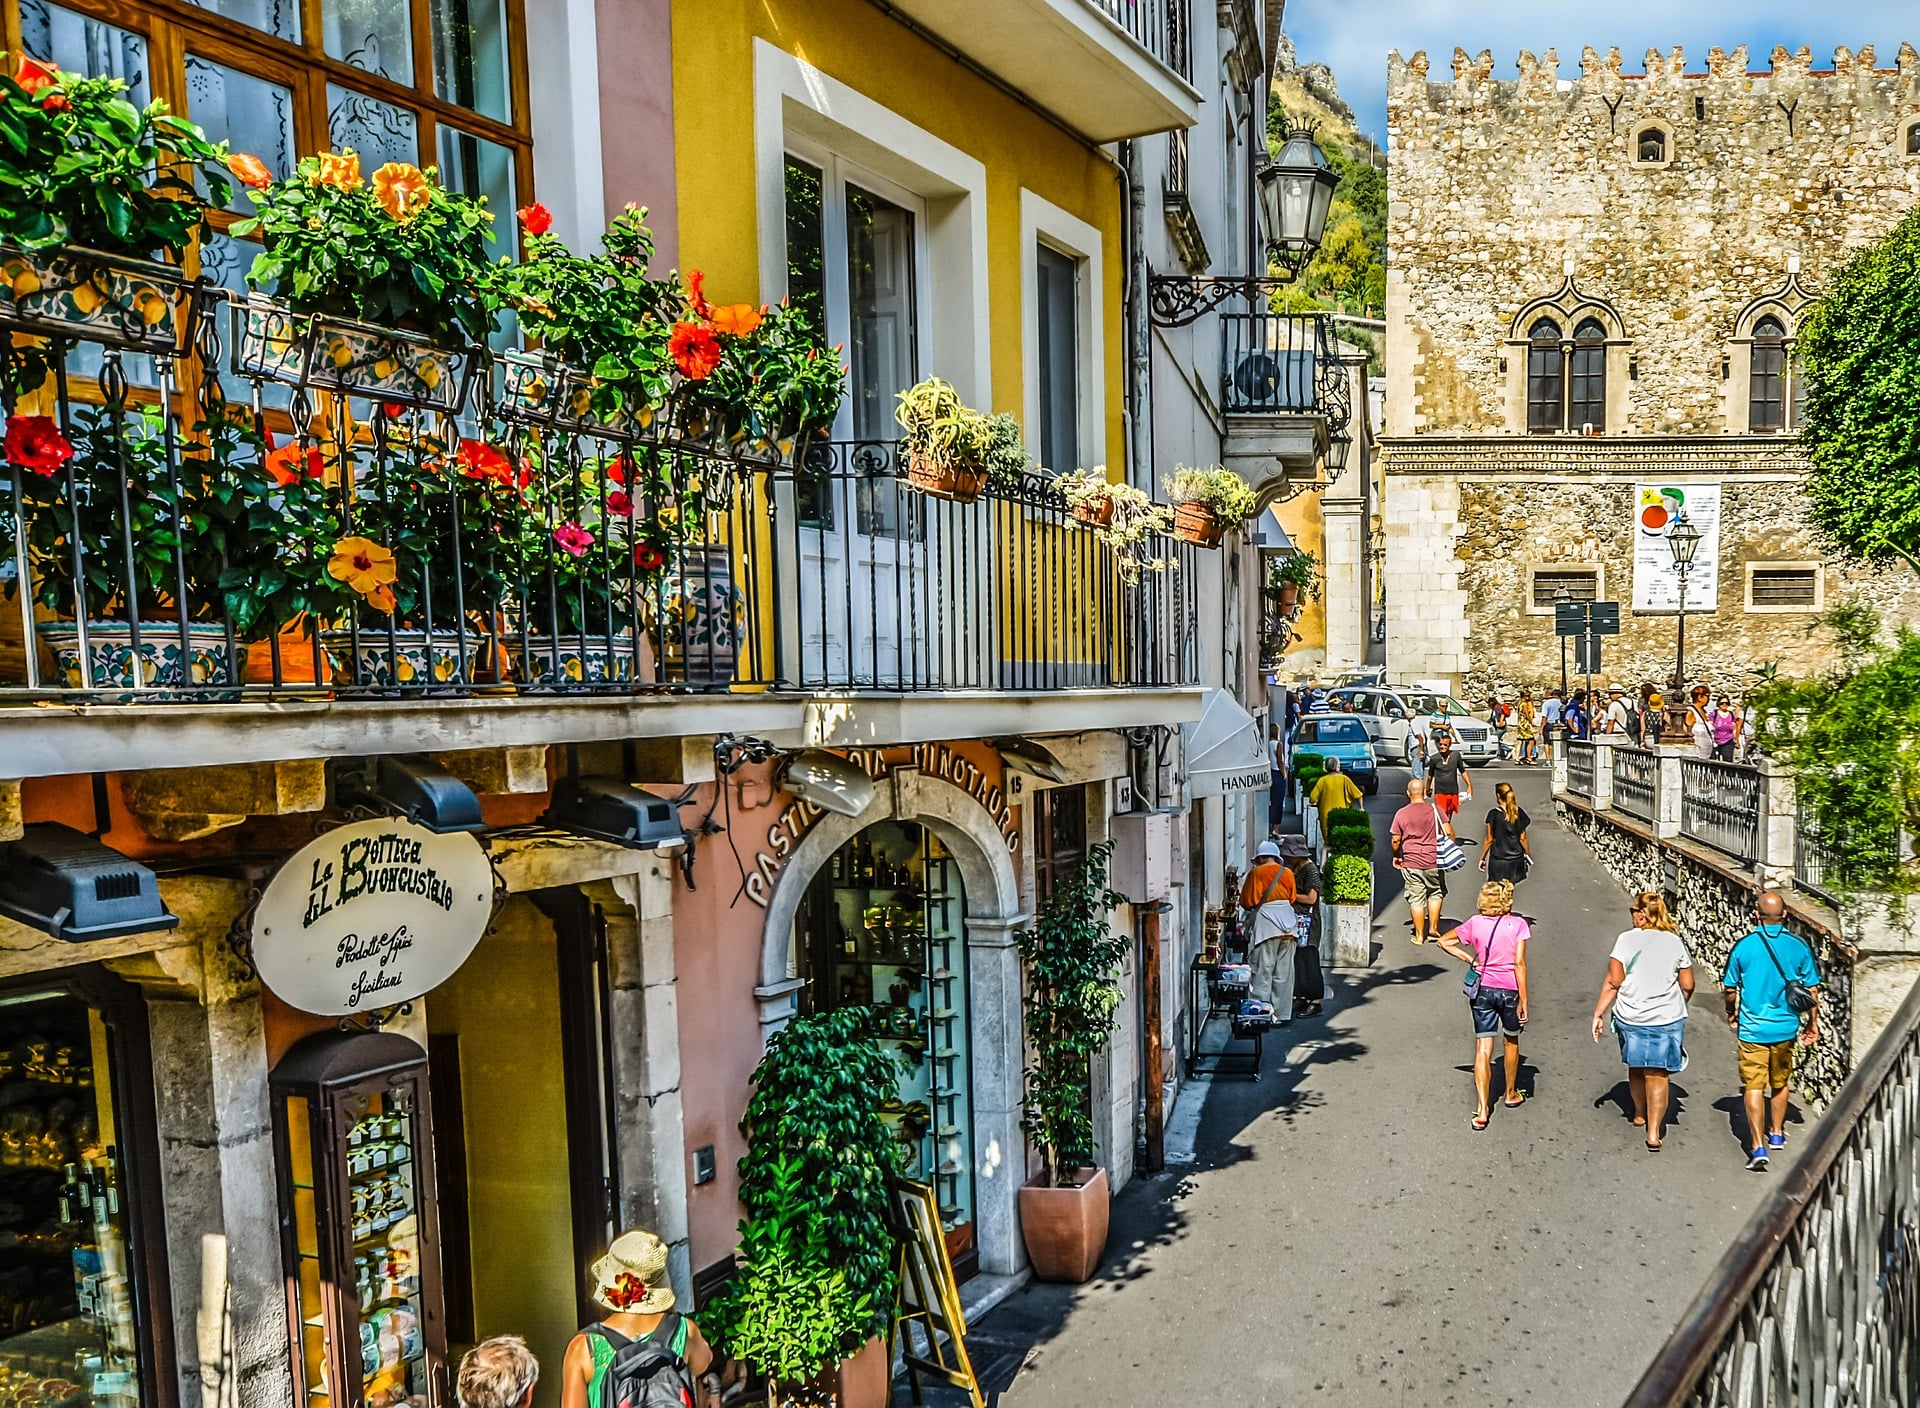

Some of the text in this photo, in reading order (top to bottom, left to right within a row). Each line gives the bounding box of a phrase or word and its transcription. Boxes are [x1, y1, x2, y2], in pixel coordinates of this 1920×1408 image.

[914, 743, 1019, 853] MINOTAURO
[1011, 776, 1023, 794] 15
[1120, 787, 1130, 803] 13
[310, 858, 333, 891] La
[336, 925, 414, 968] Prodotti Tipici
[348, 970, 403, 1007] Siciliani
